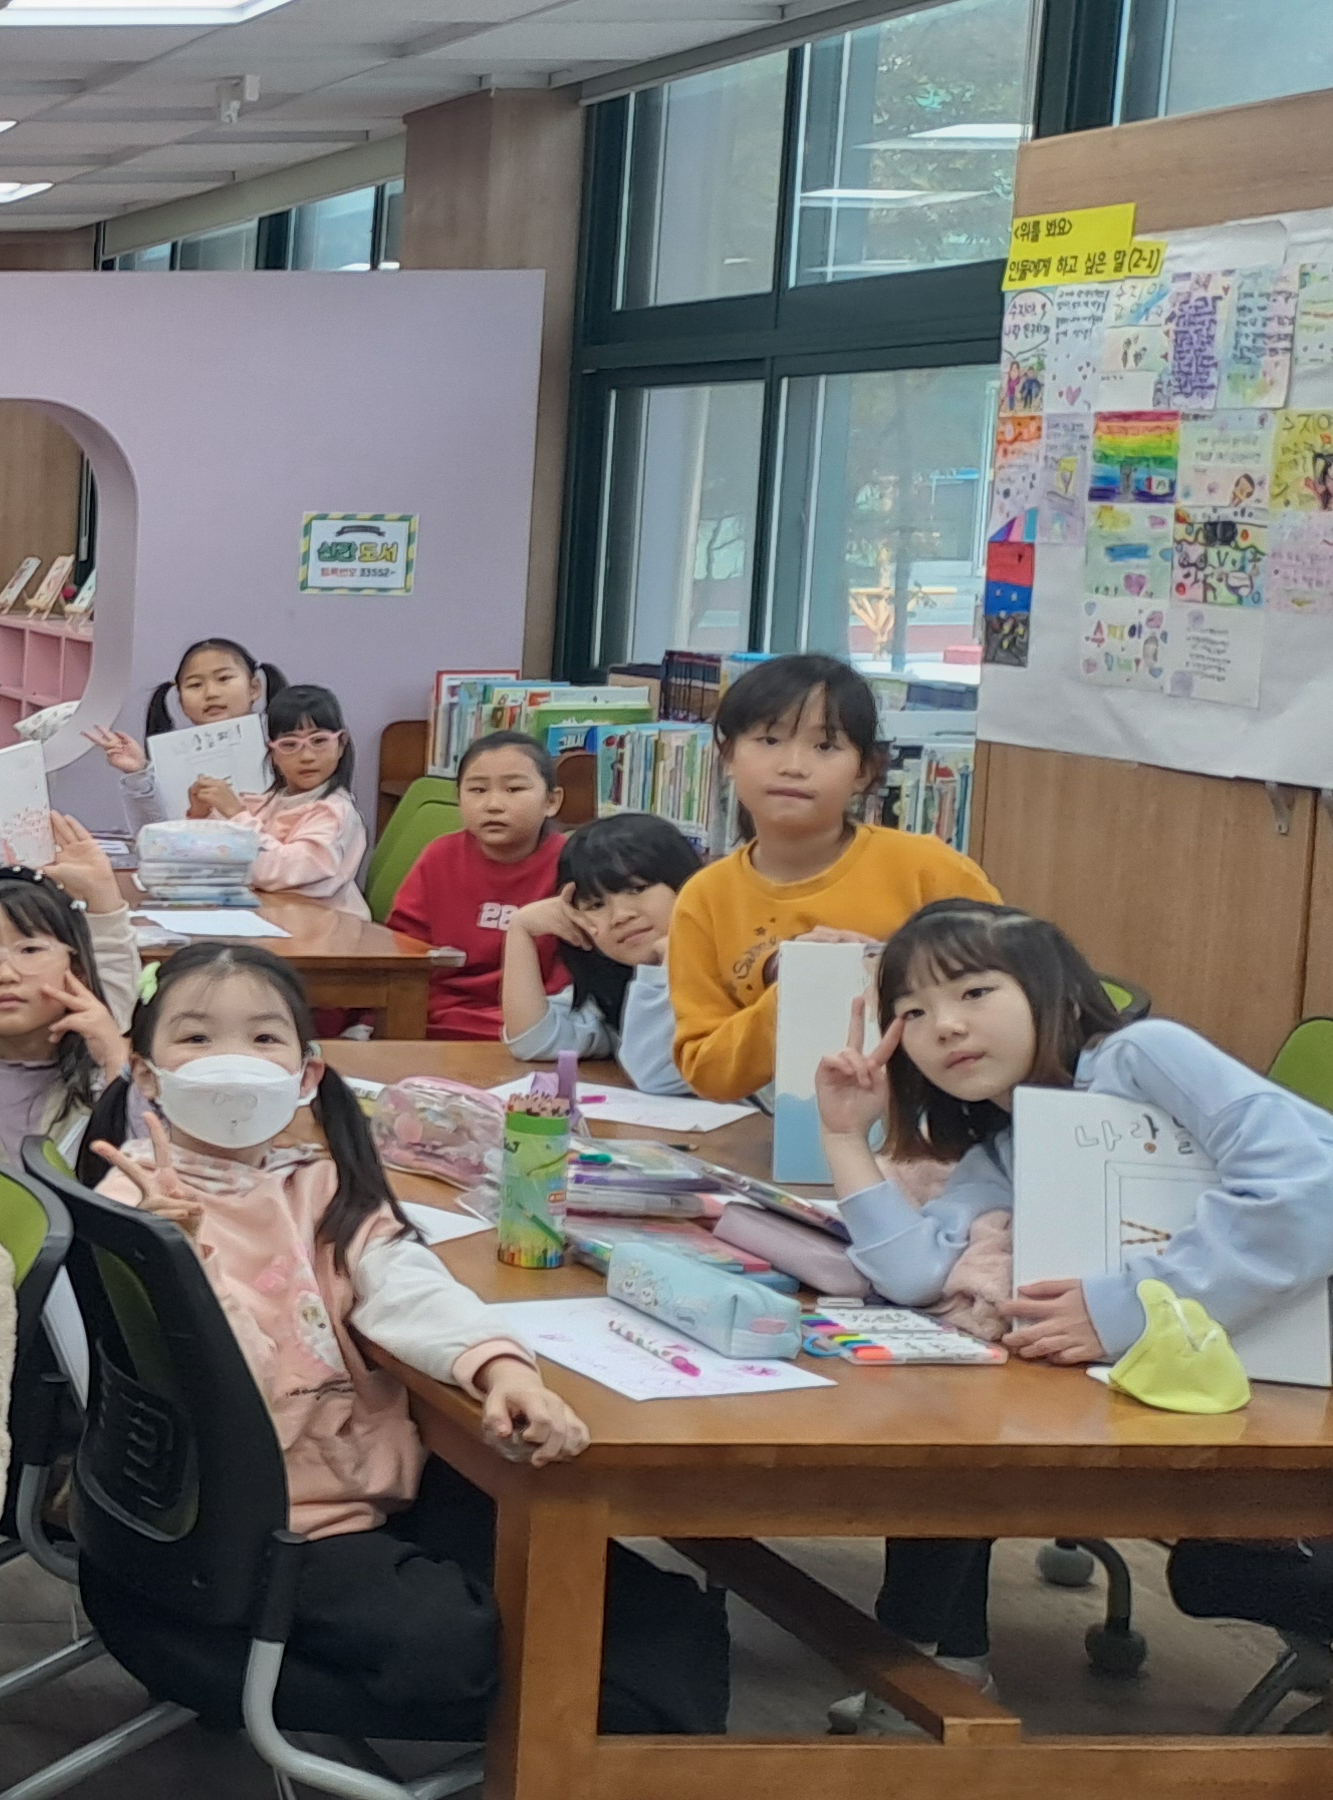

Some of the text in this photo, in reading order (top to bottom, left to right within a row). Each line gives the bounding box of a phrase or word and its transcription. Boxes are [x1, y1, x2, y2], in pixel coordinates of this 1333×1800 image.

[1056, 255, 1078, 276] 하고
[358, 541, 399, 563] 도서
[1075, 1113, 1159, 1154] 나랑
